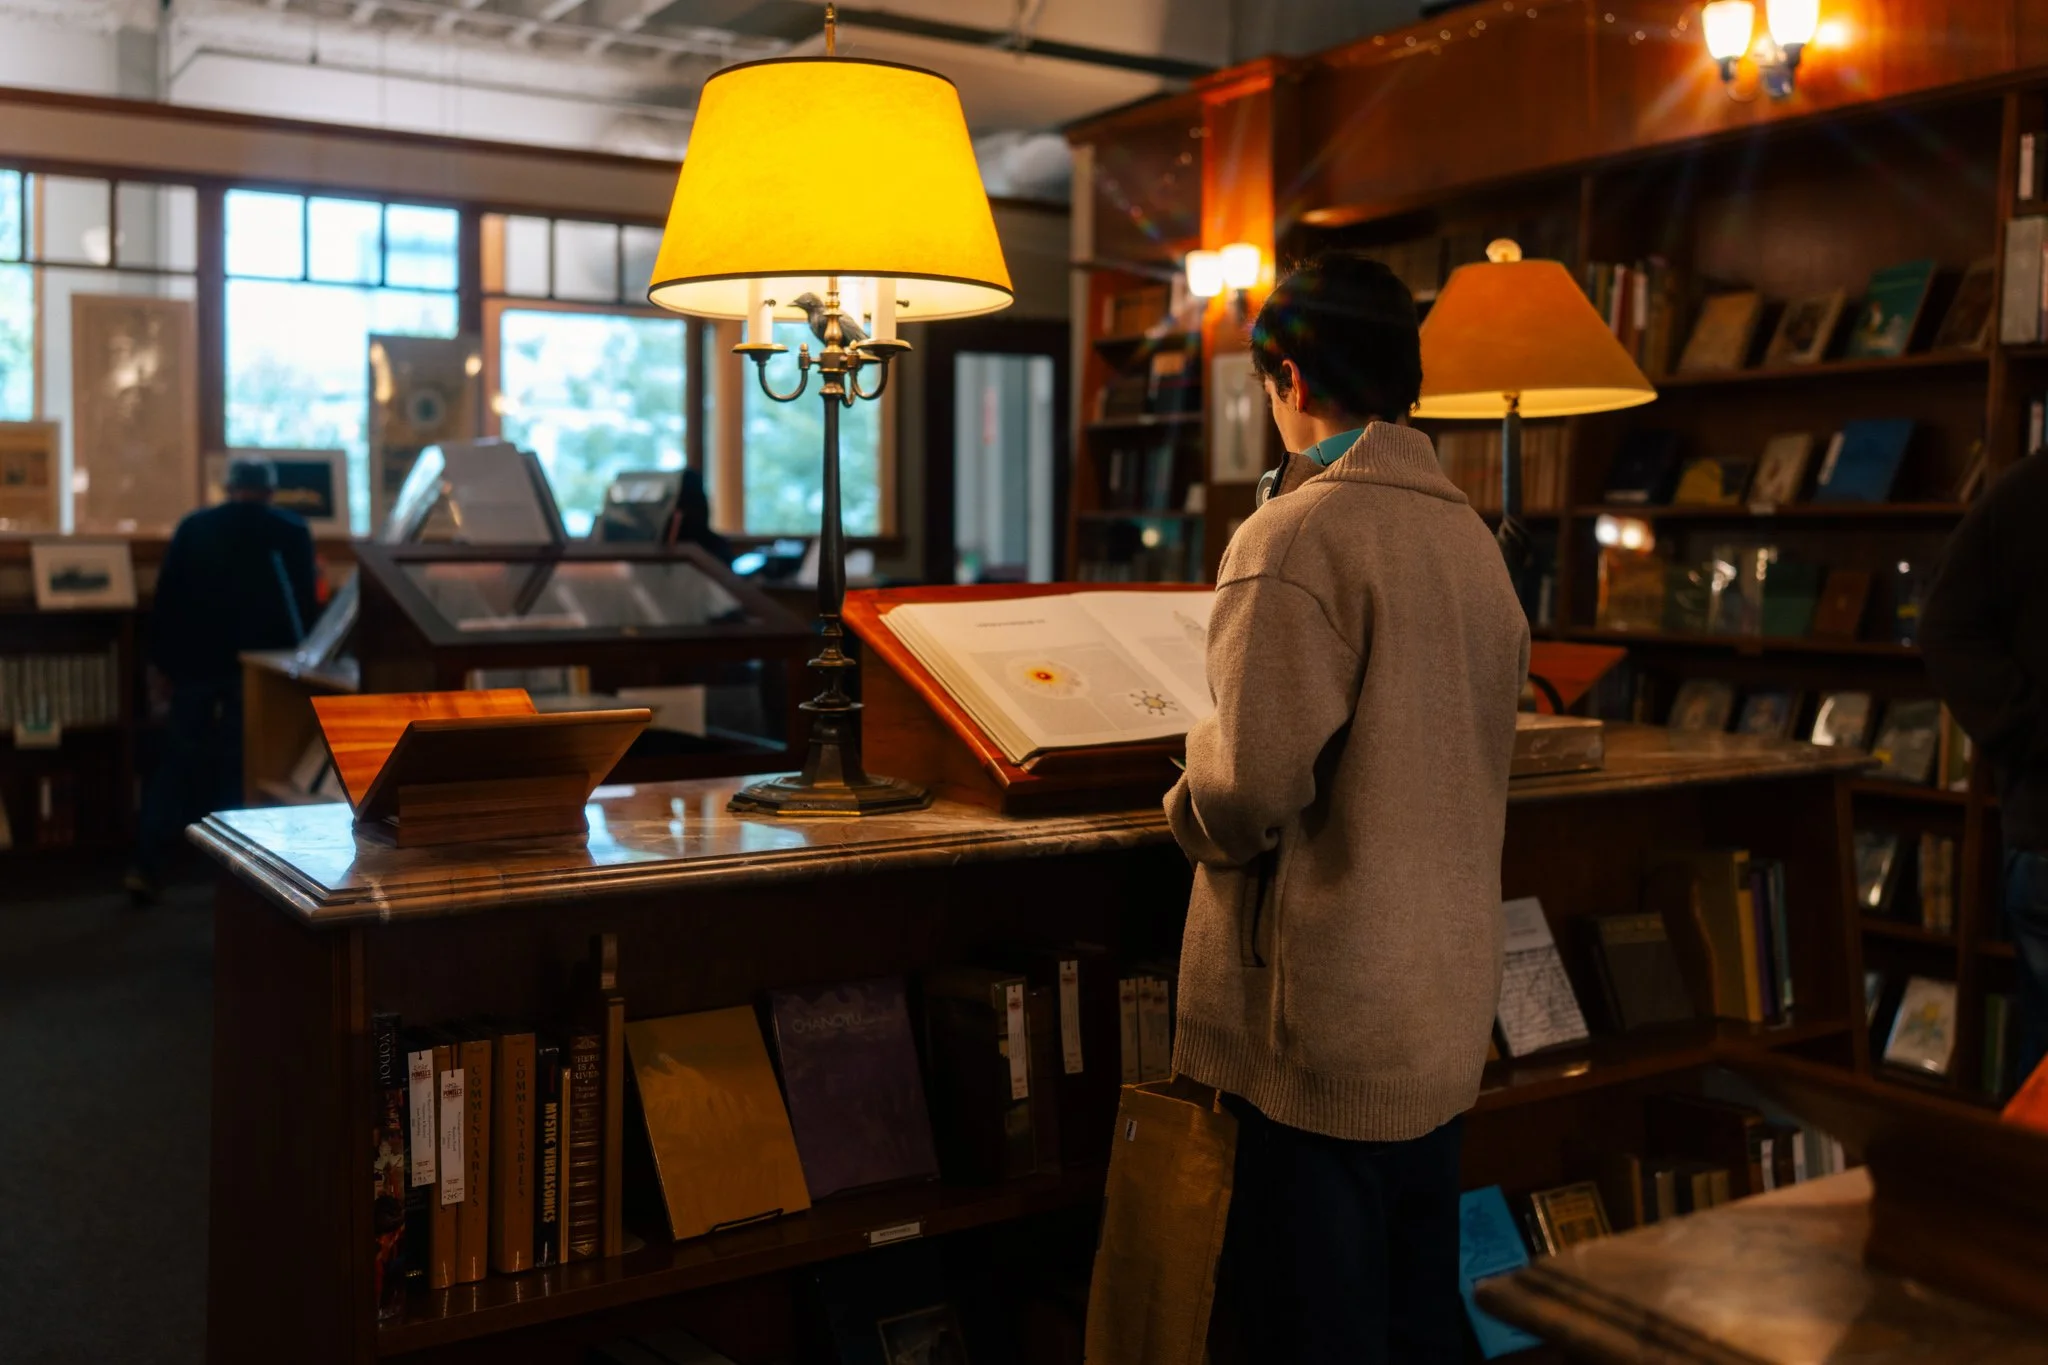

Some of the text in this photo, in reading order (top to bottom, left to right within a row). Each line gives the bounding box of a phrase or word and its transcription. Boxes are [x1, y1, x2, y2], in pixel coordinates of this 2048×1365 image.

[470, 1064, 482, 1208] COMMENTARIES
[515, 1057, 526, 1199] COMMENTARIES
[543, 1102, 558, 1144] MYSTIC
[542, 1146, 557, 1224] VIBRASONICS
